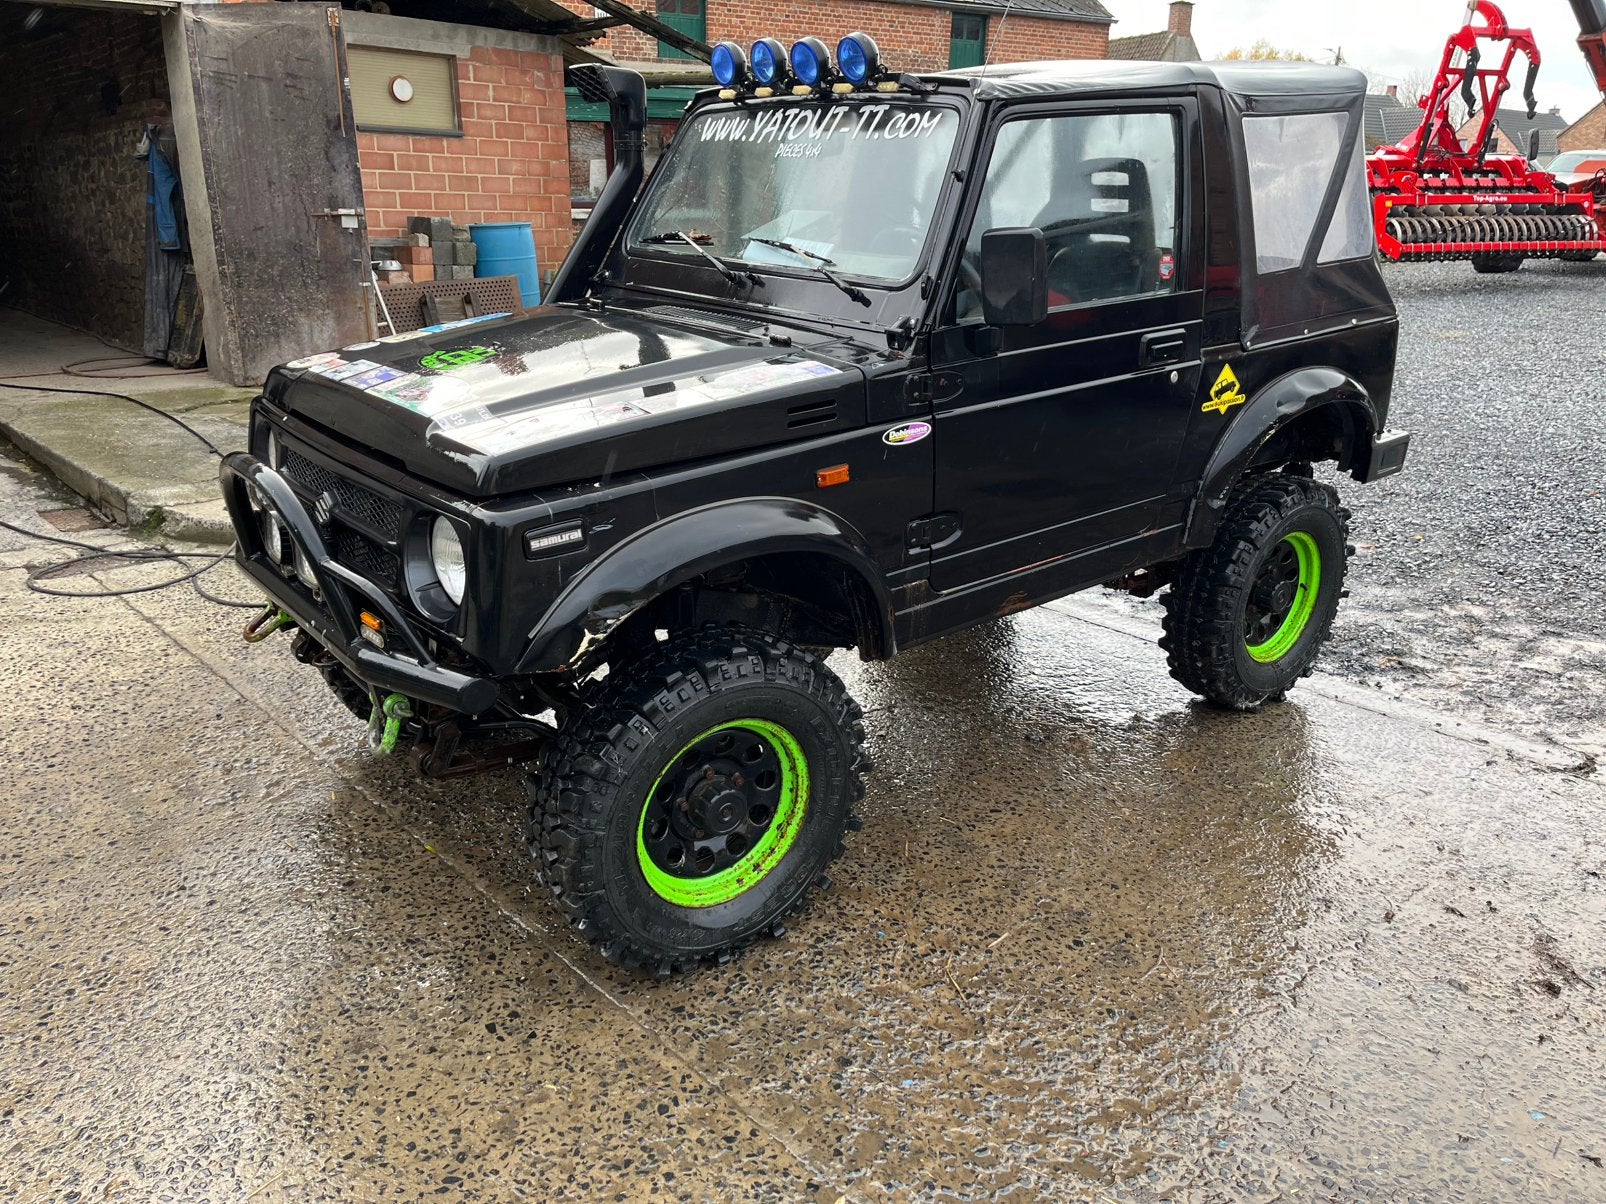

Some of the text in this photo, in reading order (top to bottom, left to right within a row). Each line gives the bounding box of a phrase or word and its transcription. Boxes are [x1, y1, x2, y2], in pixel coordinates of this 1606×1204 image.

[700, 105, 942, 144] WWW.YATOUT-TT.COM
[775, 142, 807, 158] PIECES
[889, 425, 928, 439] Dobinsons
